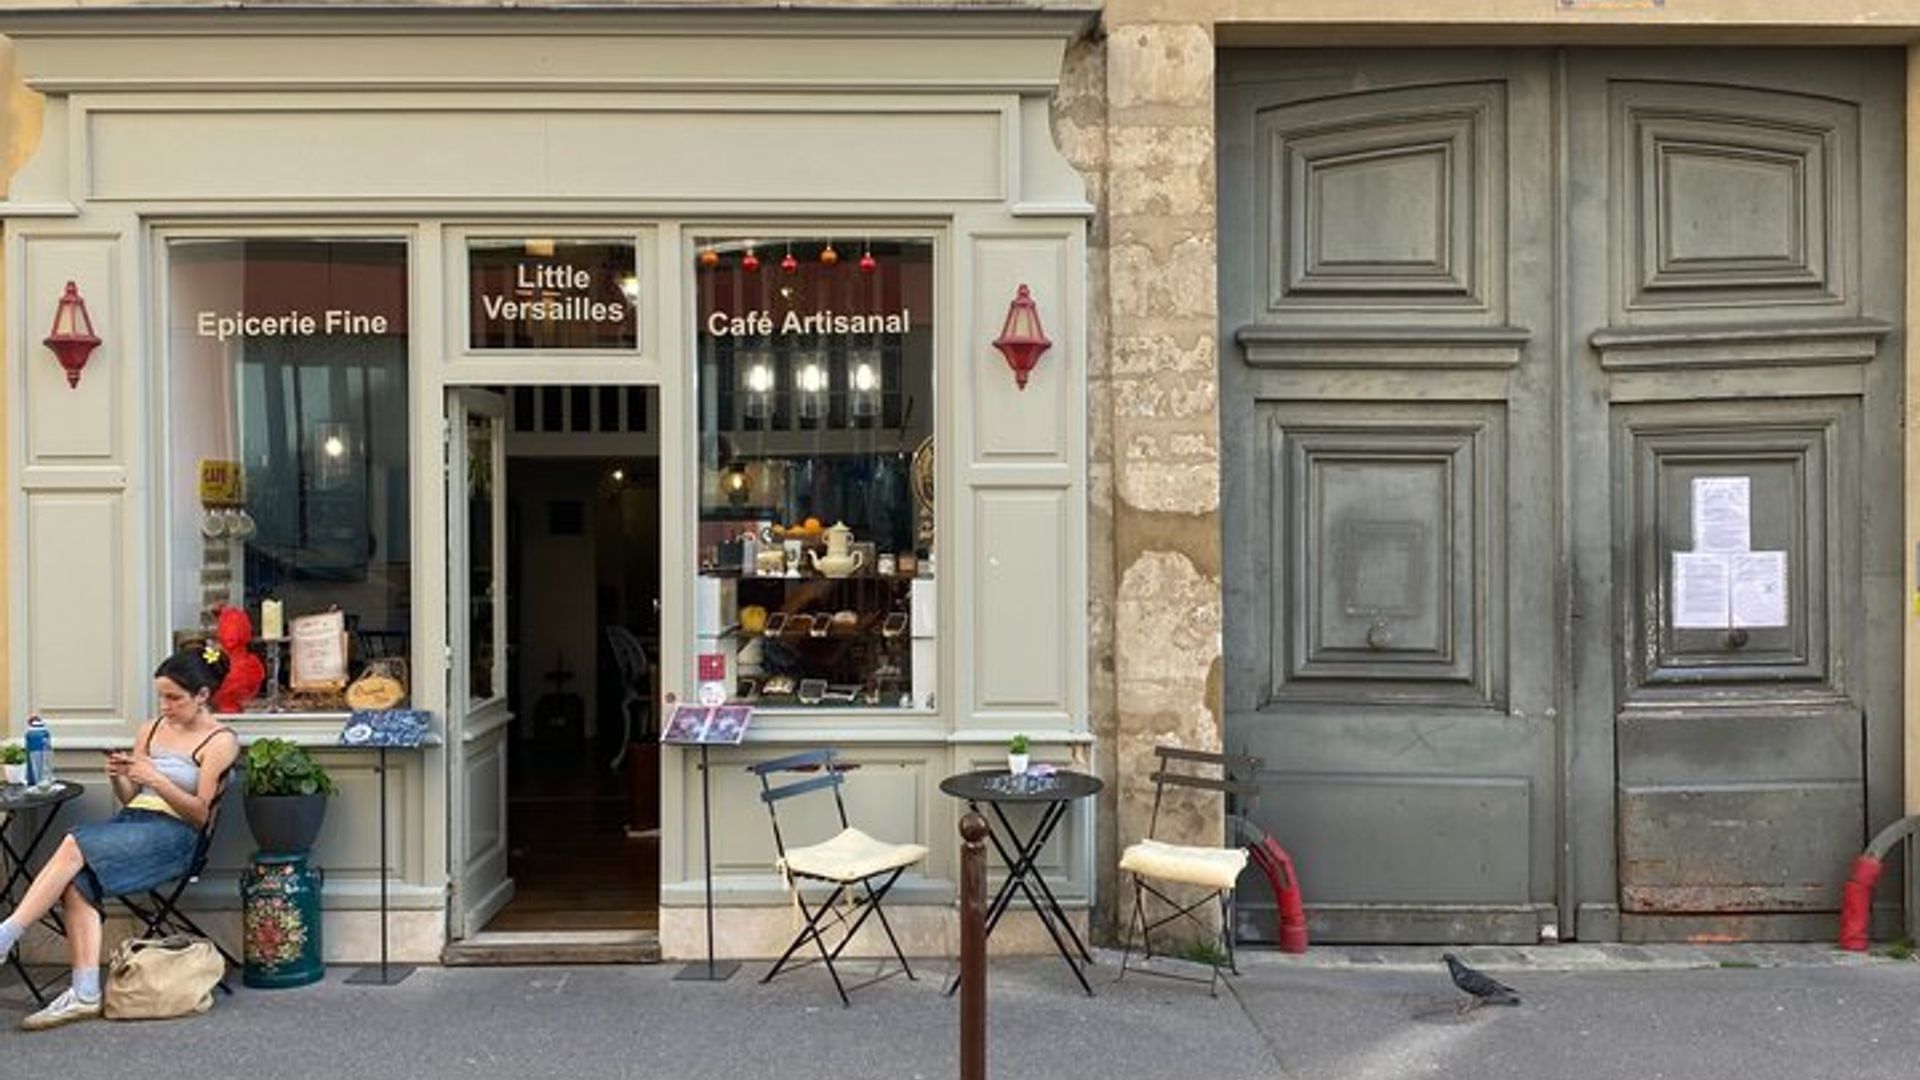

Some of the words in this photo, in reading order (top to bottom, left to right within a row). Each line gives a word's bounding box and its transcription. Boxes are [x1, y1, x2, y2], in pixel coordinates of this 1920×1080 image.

[517, 264, 591, 289] Little
[482, 295, 625, 322] Versailles
[708, 311, 773, 337] Café
[781, 308, 910, 334] Artisanal
[197, 310, 315, 341] Epicerie
[325, 309, 388, 334] Fine
